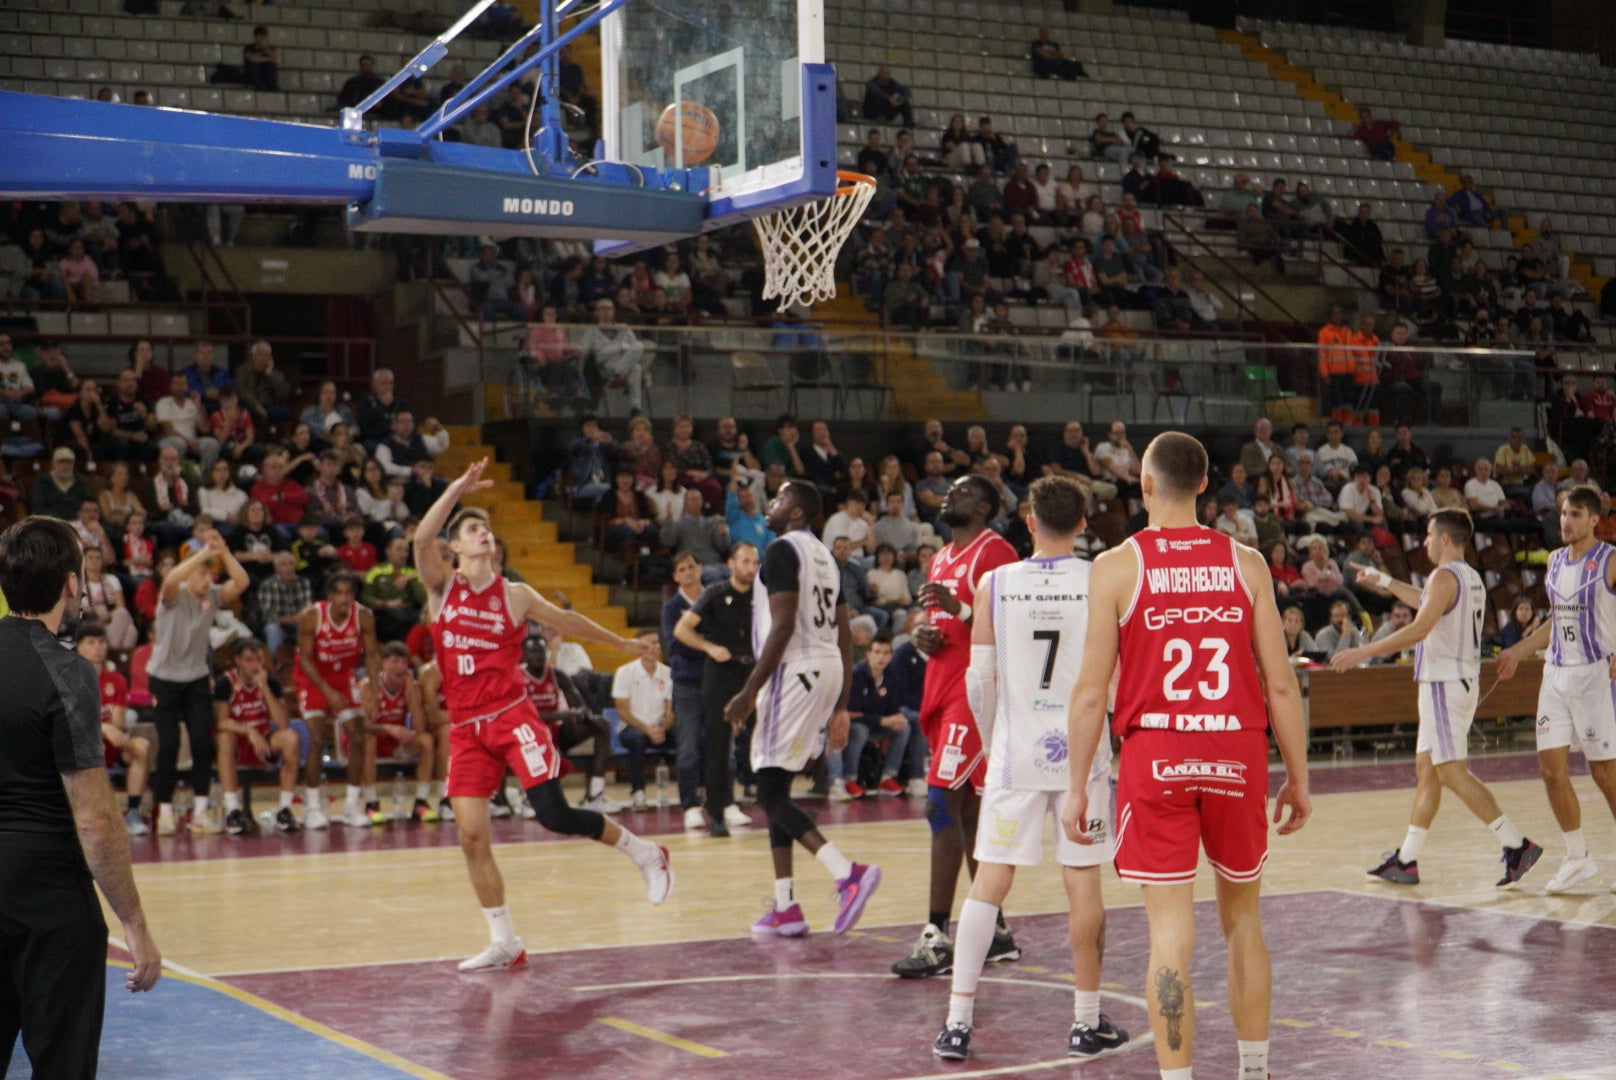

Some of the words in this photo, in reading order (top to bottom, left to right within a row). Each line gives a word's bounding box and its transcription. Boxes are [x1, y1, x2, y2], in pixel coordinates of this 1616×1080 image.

[503, 198, 574, 216] MONDO
[1146, 567, 1170, 595] VAN
[1170, 567, 1191, 593] DER
[813, 584, 838, 629] 35
[1002, 594, 1032, 602] KYLE
[1144, 606, 1243, 630] Geoxa
[1562, 626, 1576, 642] 15
[457, 654, 476, 676] 10
[1033, 630, 1060, 690] 7
[1163, 638, 1230, 701] 23
[512, 723, 536, 744] 10
[1175, 714, 1242, 732] IXMA
[947, 723, 969, 747] 17
